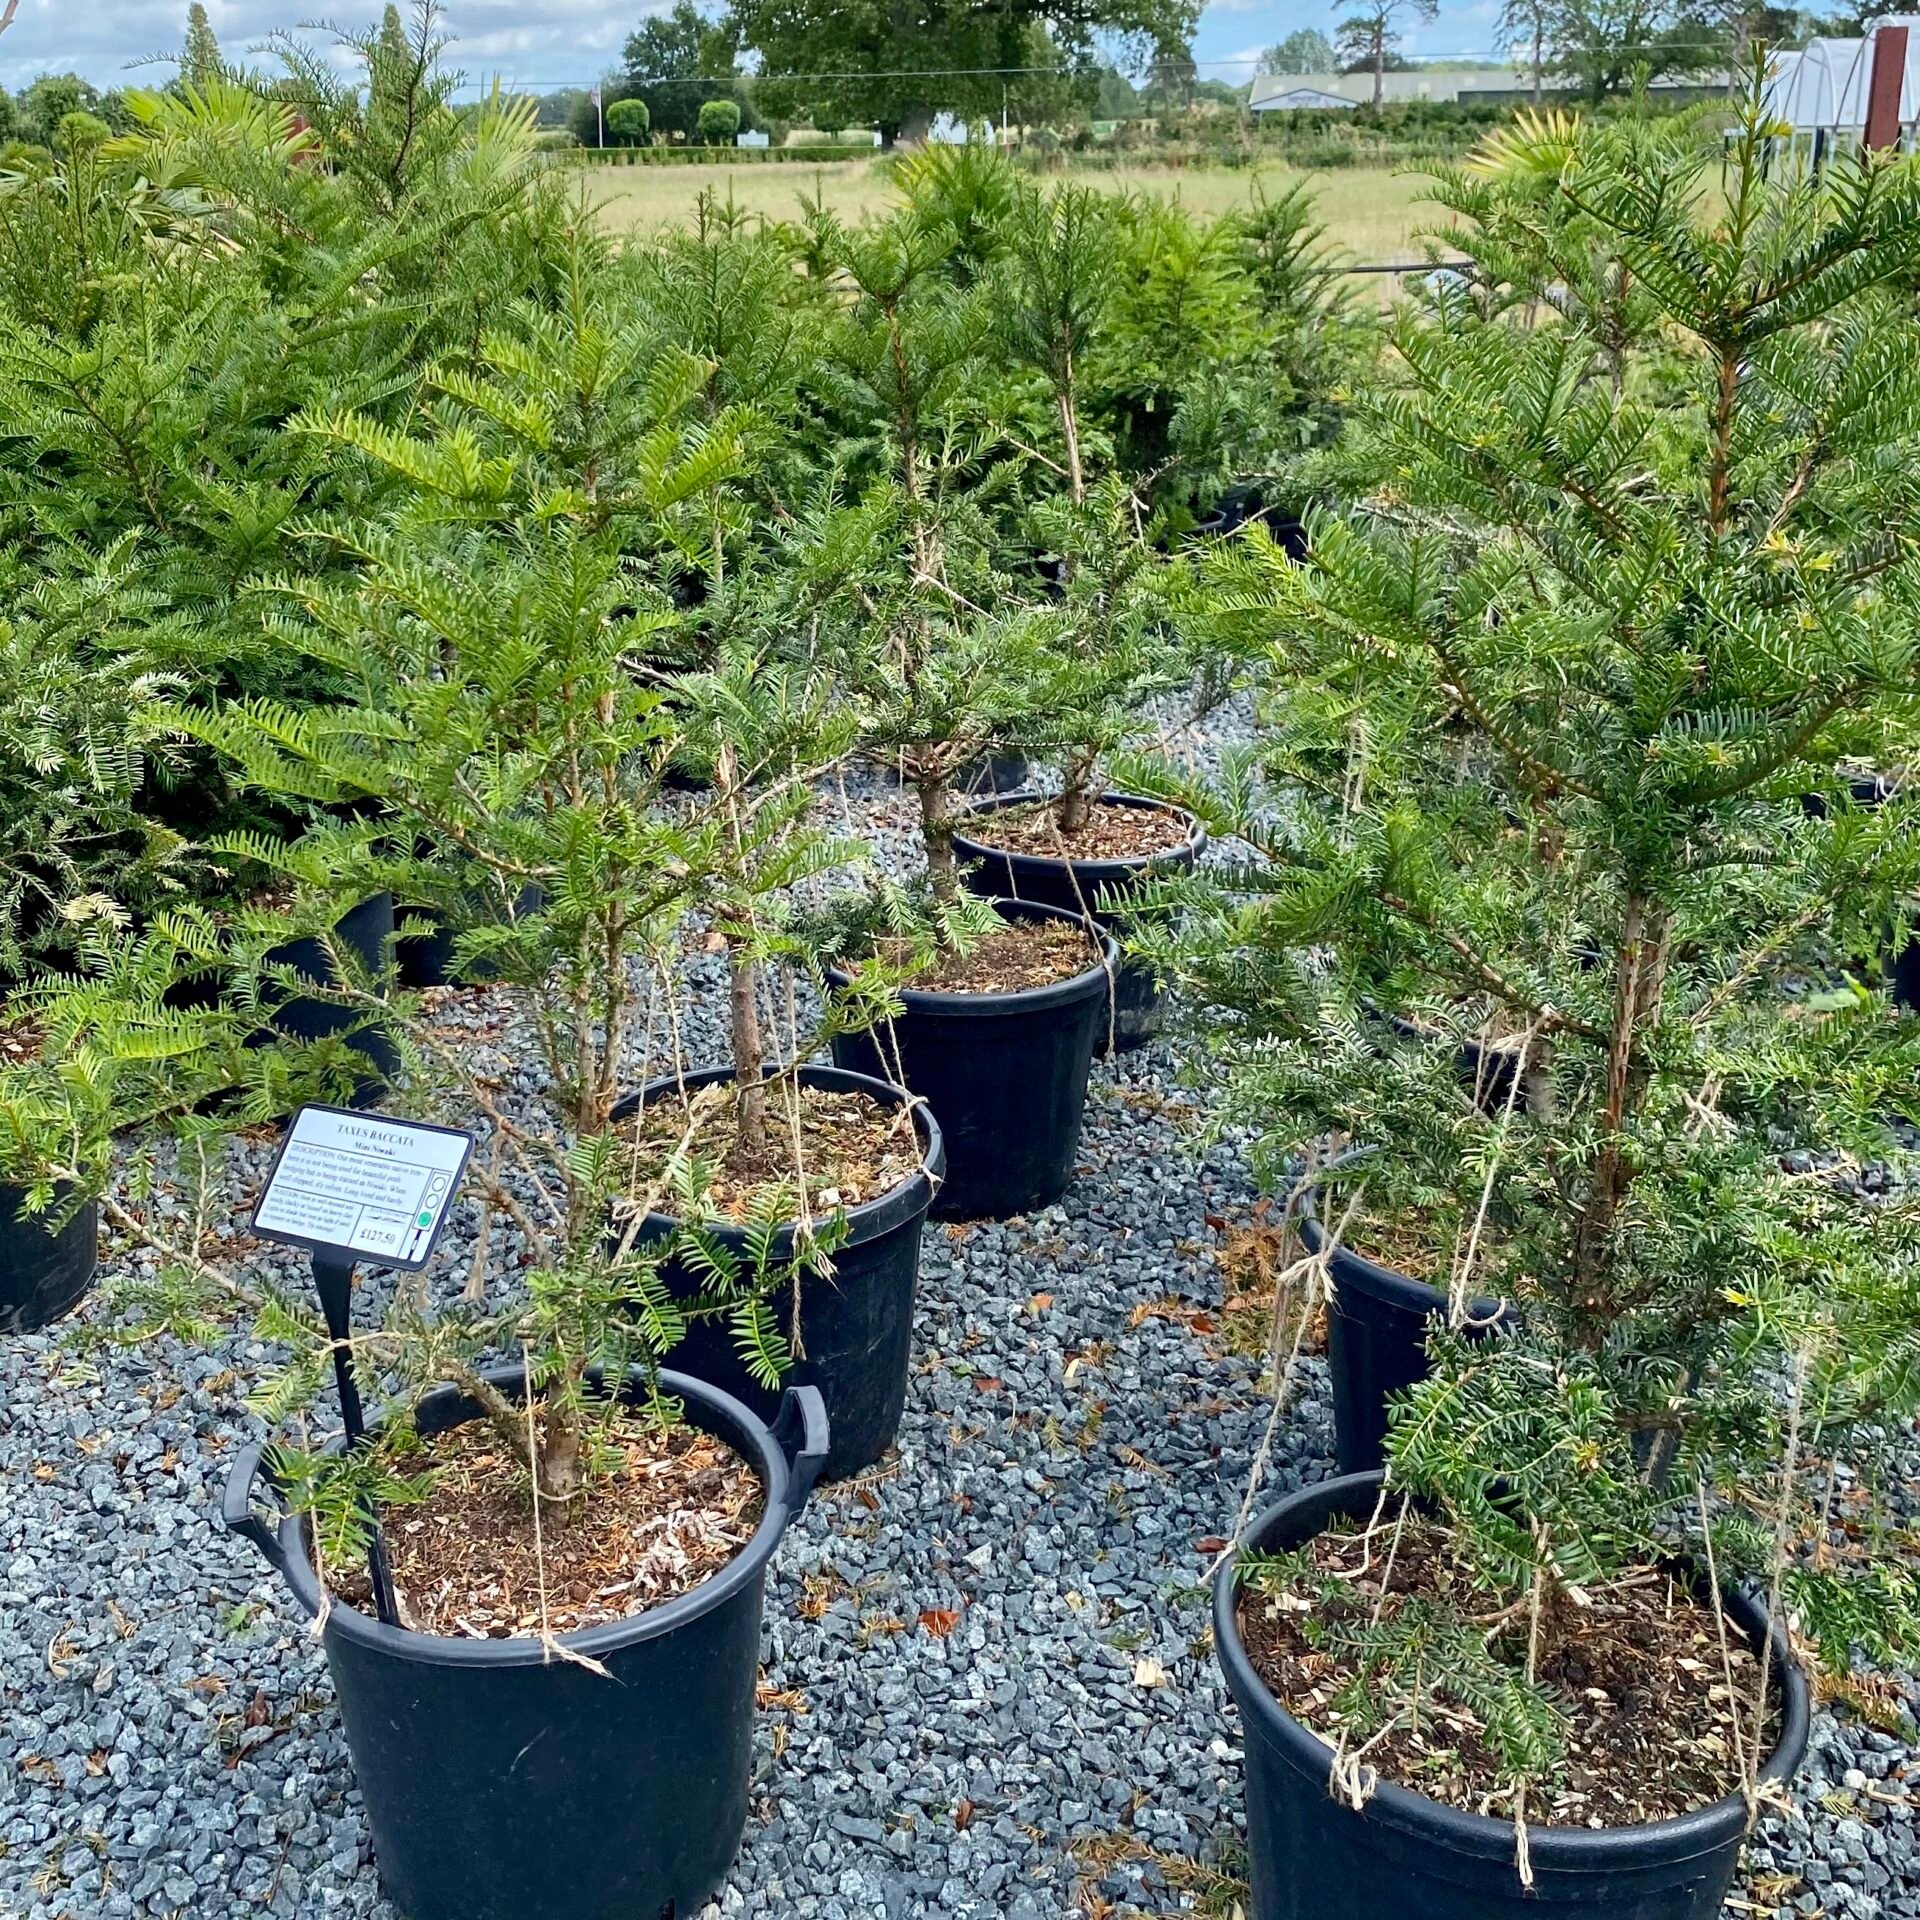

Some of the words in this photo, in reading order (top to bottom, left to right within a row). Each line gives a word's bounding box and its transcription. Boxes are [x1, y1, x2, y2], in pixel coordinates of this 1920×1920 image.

[335, 1124, 369, 1137] TAXUS
[368, 1130, 415, 1146] BACCATA
[353, 1141, 371, 1151] Mini
[359, 1227, 396, 1244] £127.50
